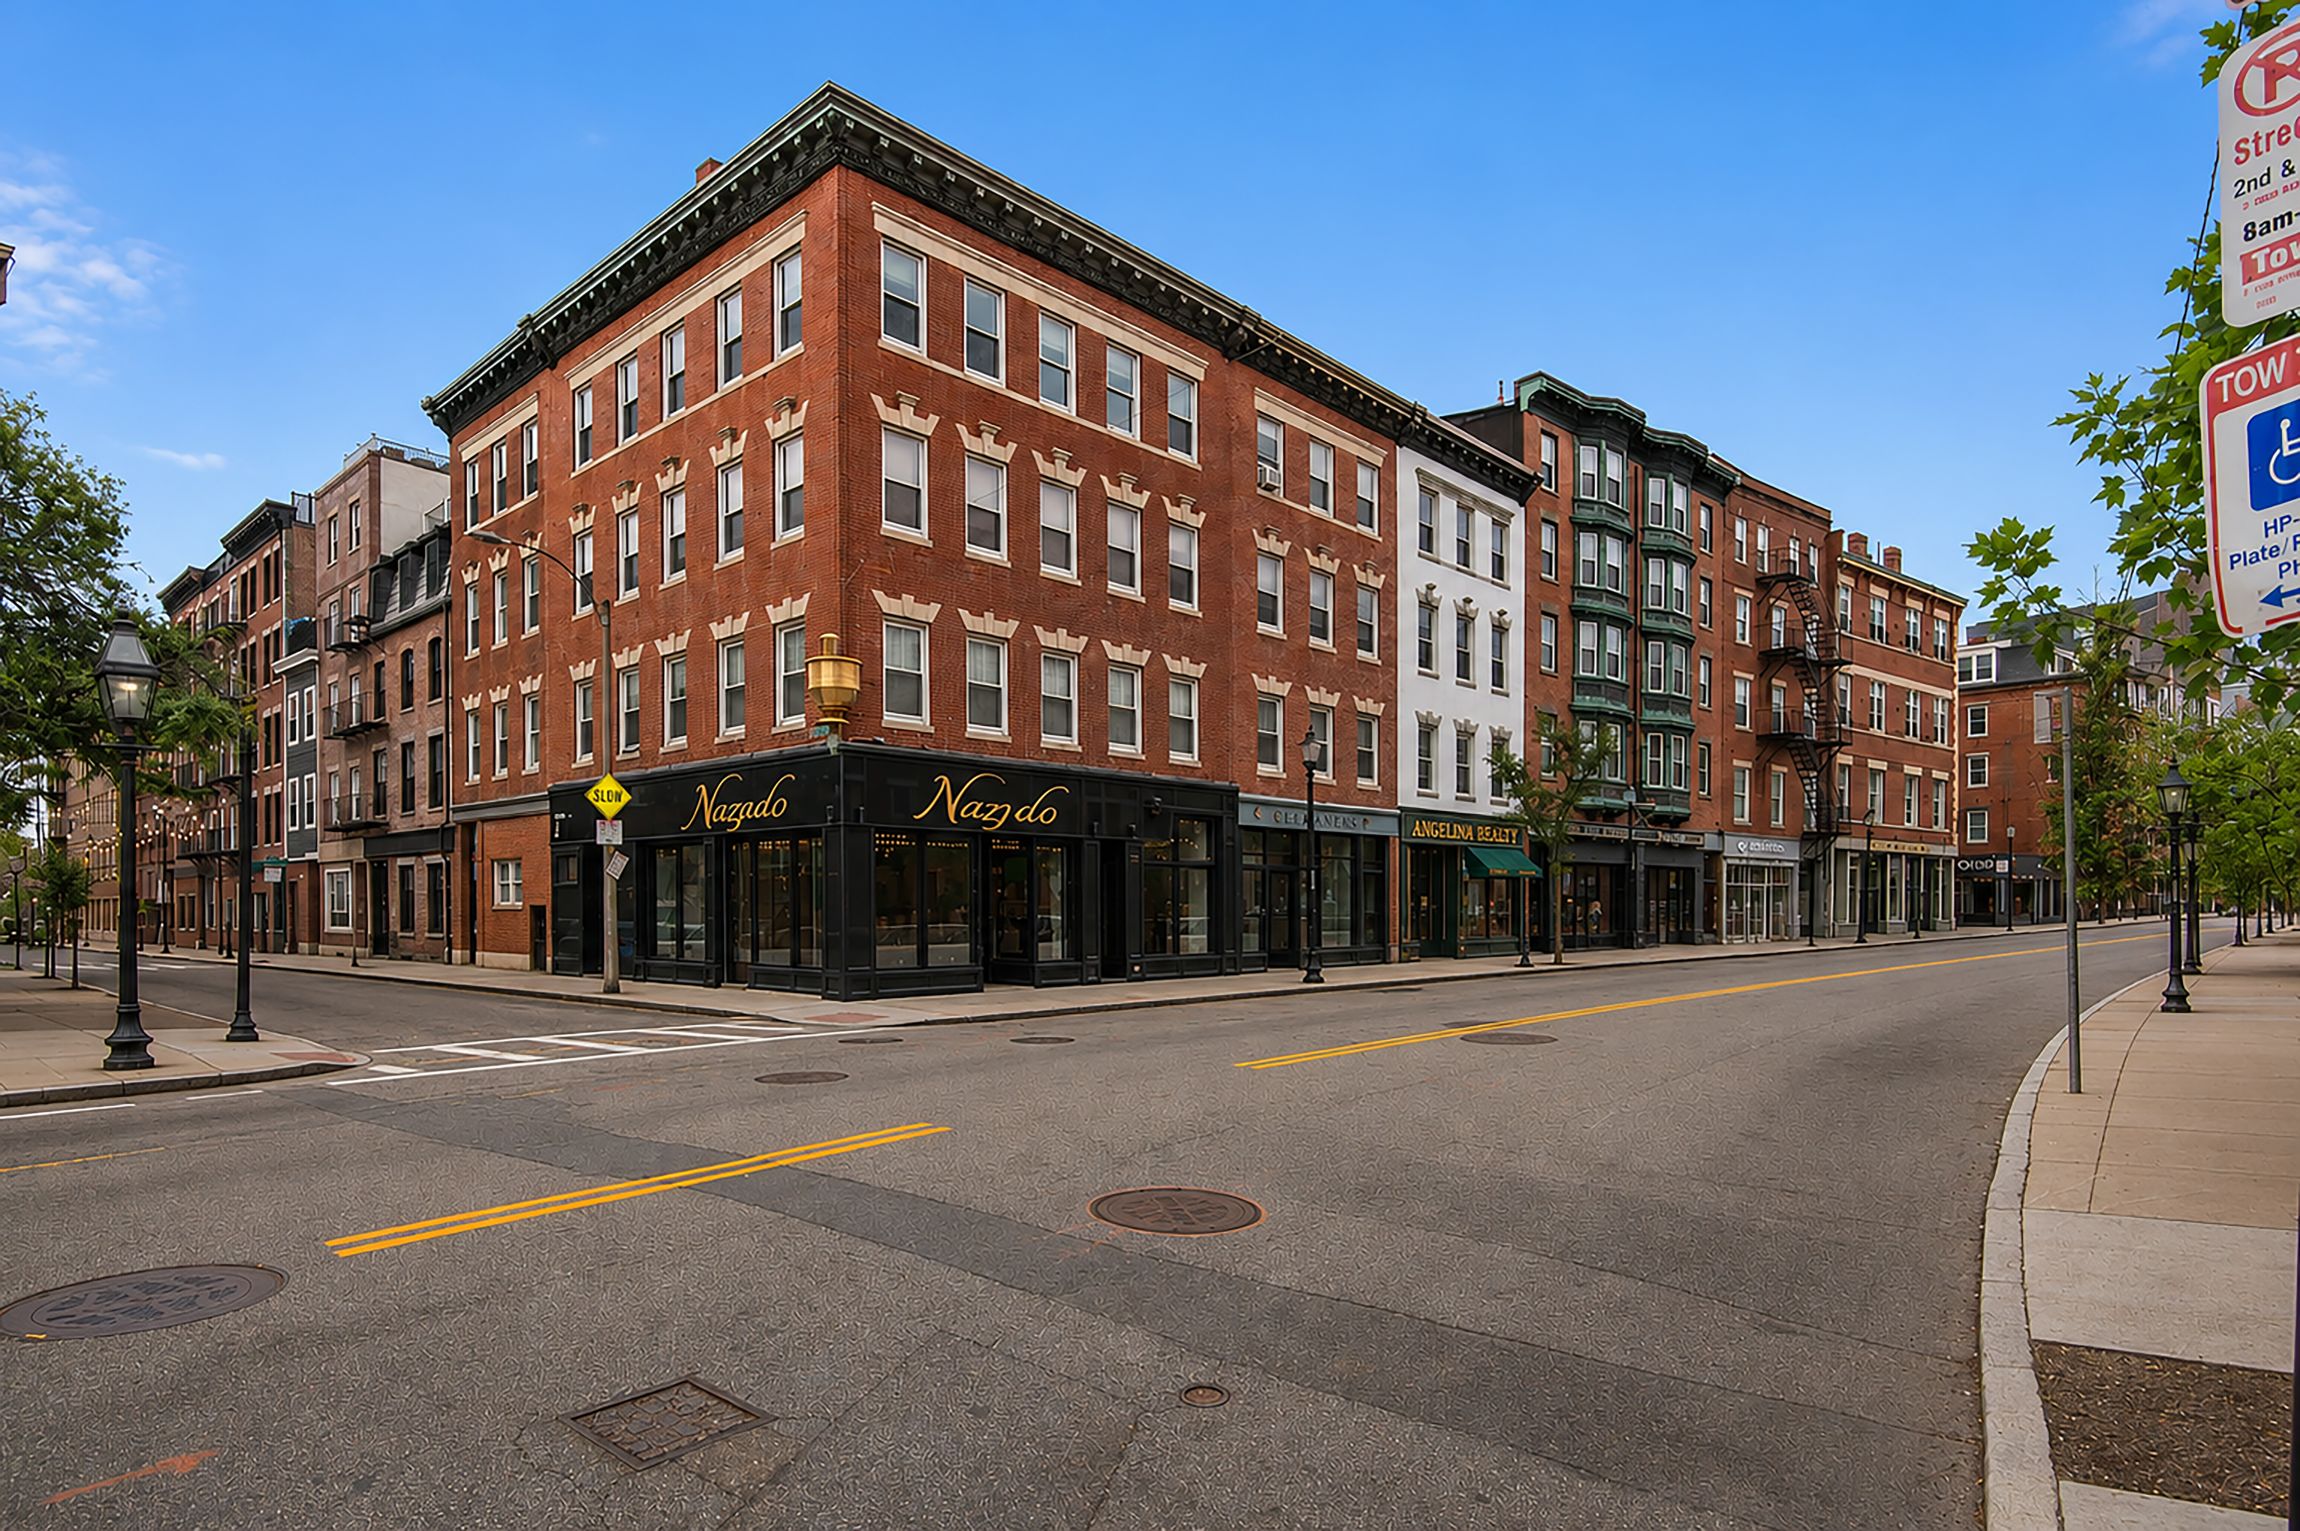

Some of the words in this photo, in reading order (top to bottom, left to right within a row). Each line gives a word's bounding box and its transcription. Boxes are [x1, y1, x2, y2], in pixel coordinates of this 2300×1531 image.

[2233, 166, 2271, 199] 2nd
[2281, 158, 2297, 178] &
[2214, 352, 2287, 403] TOW
[681, 773, 795, 832] Nazado
